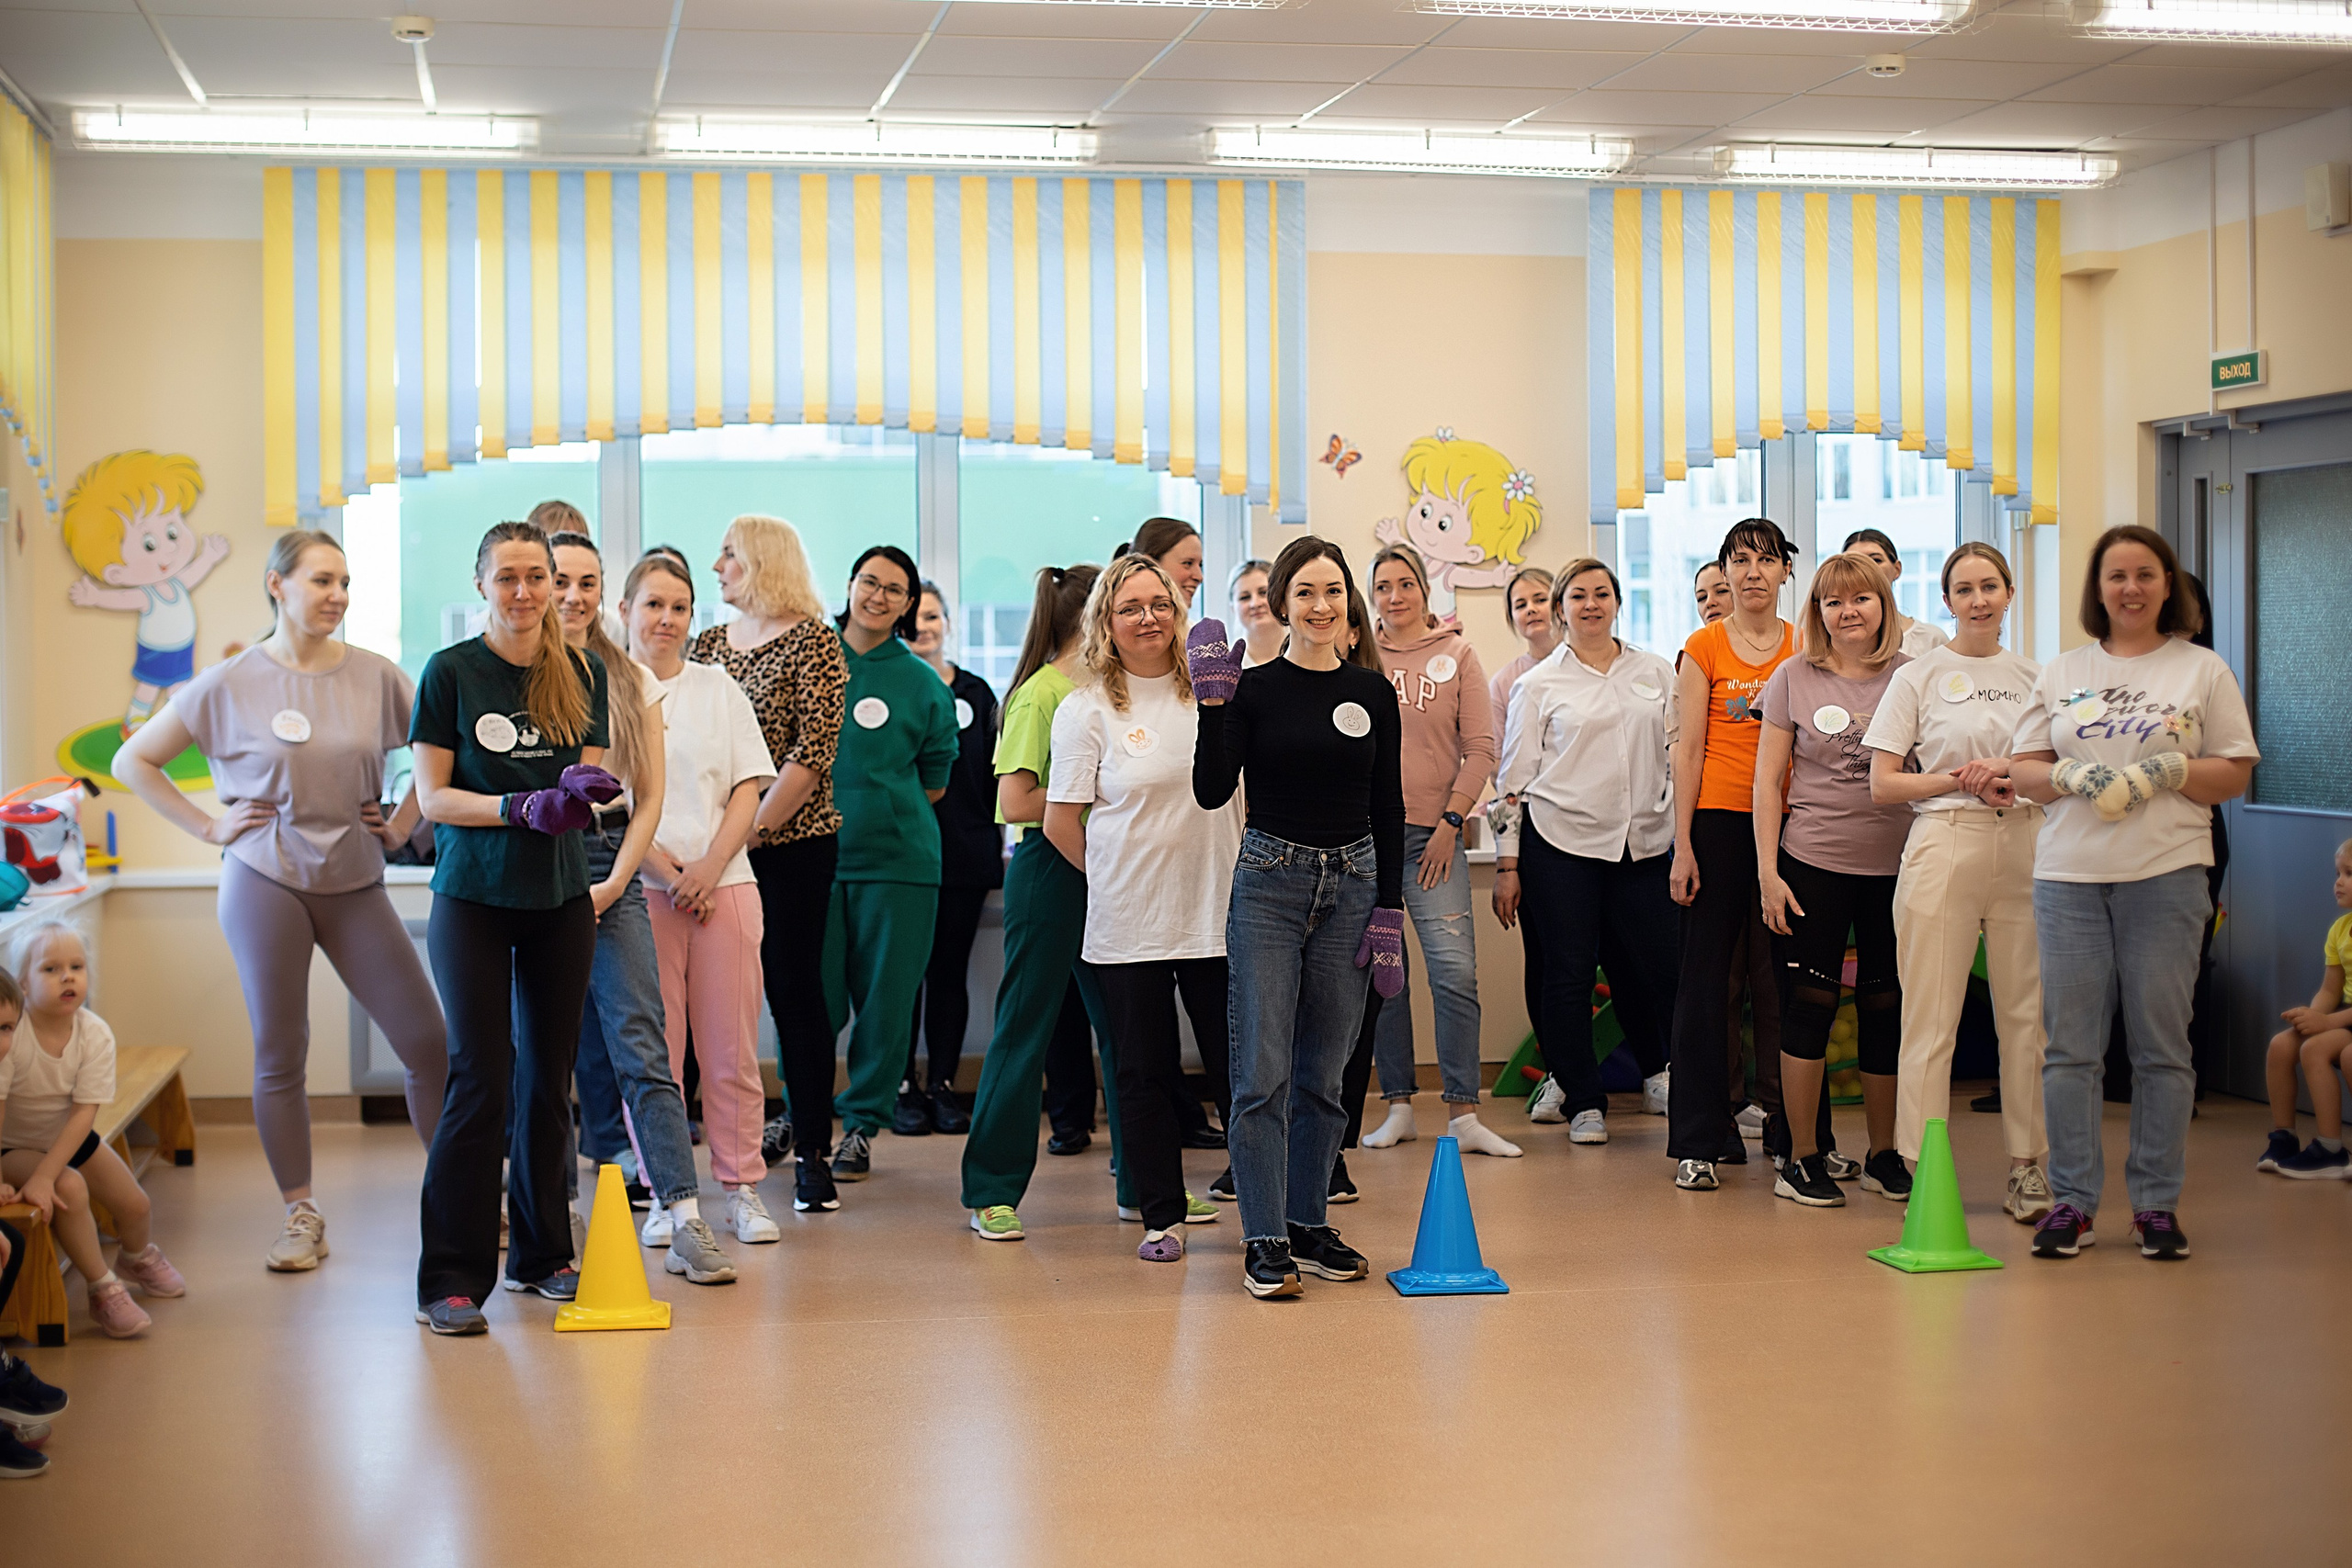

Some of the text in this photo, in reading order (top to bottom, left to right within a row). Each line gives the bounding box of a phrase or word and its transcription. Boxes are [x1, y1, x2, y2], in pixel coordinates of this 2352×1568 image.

[2219, 362, 2251, 379] ВЫХОД
[1390, 668, 1438, 713] AP
[2075, 716, 2162, 744] City
